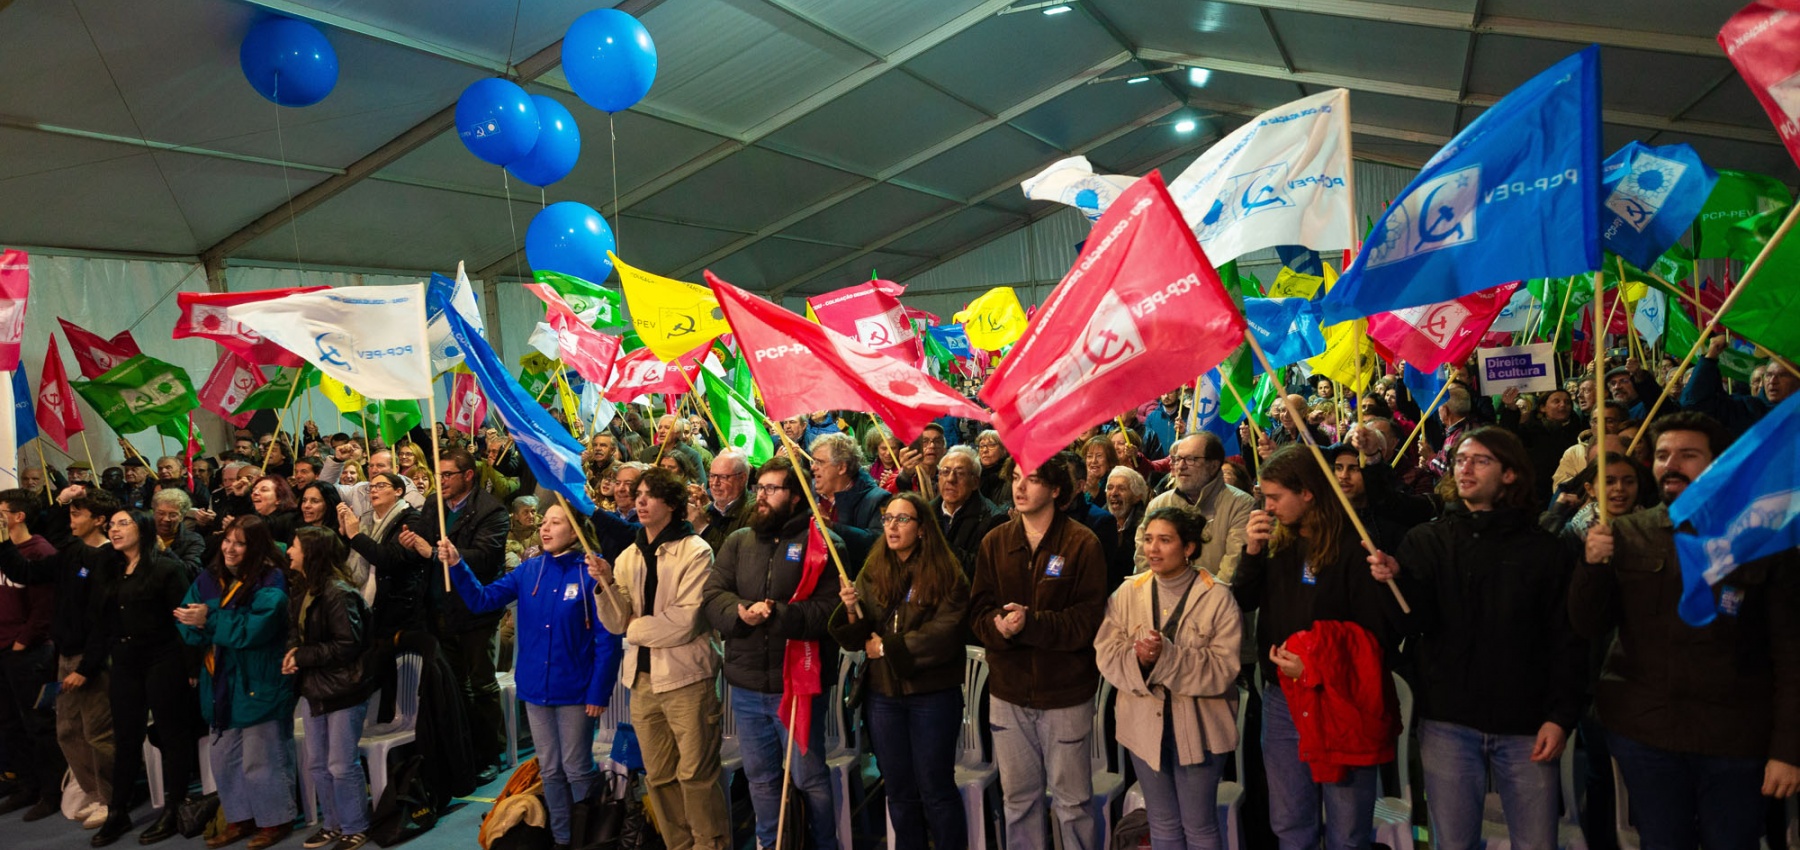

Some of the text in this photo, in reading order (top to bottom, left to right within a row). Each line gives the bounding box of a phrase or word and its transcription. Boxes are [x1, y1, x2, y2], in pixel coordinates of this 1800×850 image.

[1702, 209, 1754, 221] PCP-PEV
[632, 319, 656, 329] -PEV
[1487, 357, 1526, 368] Direito
[1488, 367, 1540, 379] à cultura
